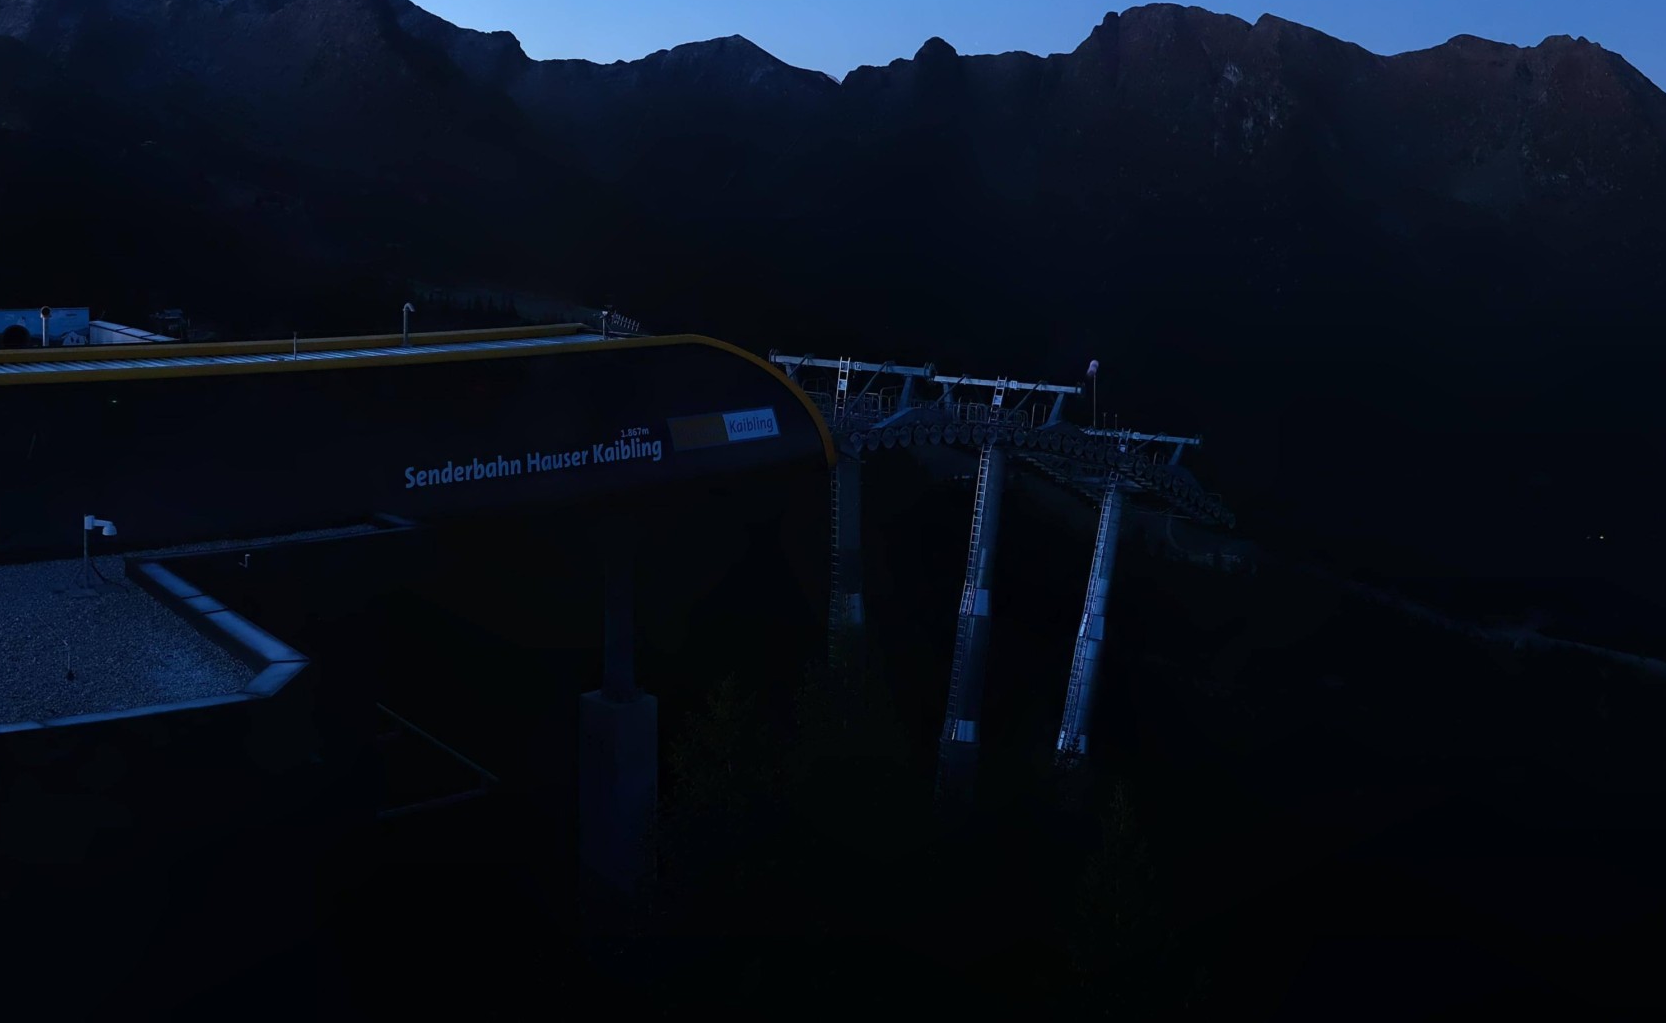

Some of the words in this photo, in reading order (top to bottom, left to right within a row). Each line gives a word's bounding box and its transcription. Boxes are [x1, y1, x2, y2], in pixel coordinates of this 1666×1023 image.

[620, 427, 650, 438] 1.867m
[729, 417, 774, 433] Kaibling
[405, 455, 521, 489] Senderbahn
[526, 447, 589, 473] Hauser
[593, 437, 662, 463] Kaibling
